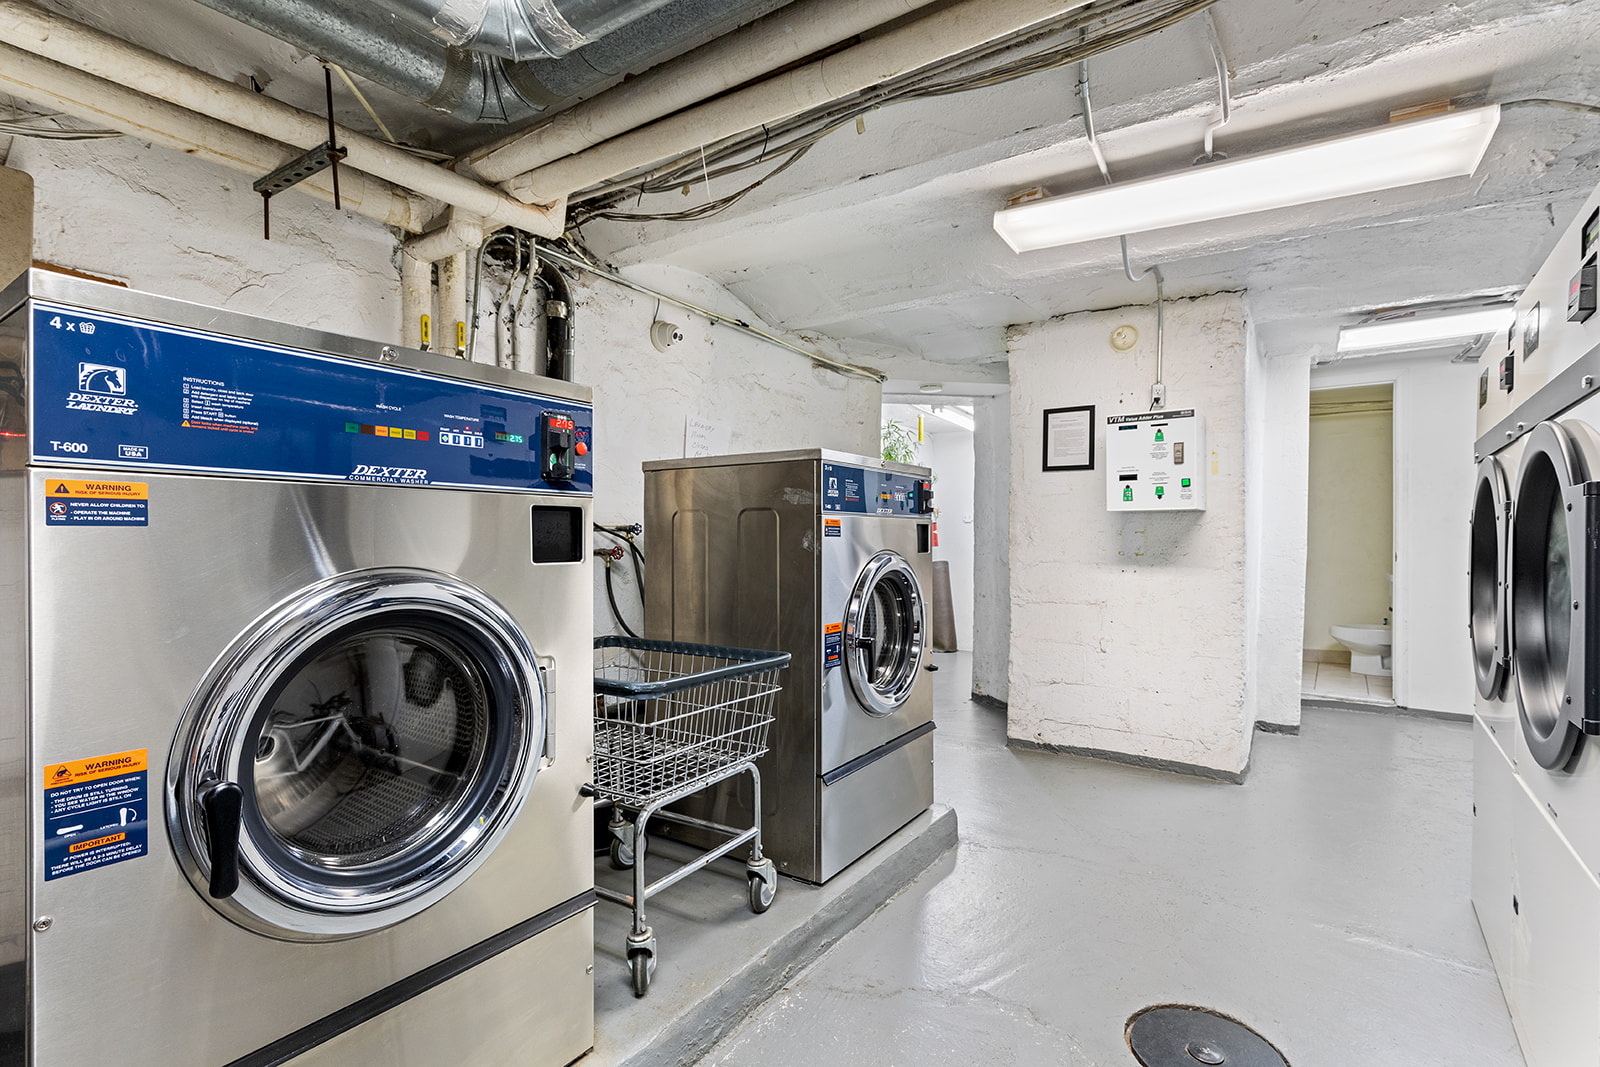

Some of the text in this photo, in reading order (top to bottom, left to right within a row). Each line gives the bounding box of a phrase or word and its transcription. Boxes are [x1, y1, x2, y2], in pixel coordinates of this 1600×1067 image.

[50, 316, 75, 332] 4 x
[183, 376, 225, 387] INSTRUCTIONS
[66, 401, 138, 415] LAUNDRY
[50, 440, 88, 453] T-600
[348, 474, 398, 483] COMMERCIAL
[351, 464, 427, 479] DEXTER
[85, 484, 132, 492] WARNING
[85, 756, 132, 770] WARNING
[98, 765, 121, 773] SERIOUS
[93, 781, 108, 789] OPEN
[109, 778, 124, 786] DOOR
[66, 793, 83, 801] DRUM
[90, 789, 104, 797] STILL
[105, 785, 128, 794] TURNING
[79, 795, 98, 804] WATER
[117, 787, 139, 795] WINDOW
[67, 803, 85, 811] CYCLE
[73, 834, 121, 850] IMPORTANT
[51, 863, 69, 871] THERE
[106, 849, 125, 858] MINUTE
[126, 844, 143, 853] DELAY
[52, 867, 73, 876] BEFORE
[86, 860, 101, 868] DOOR
[121, 849, 142, 858] OPENED
[69, 852, 89, 861] POWER
